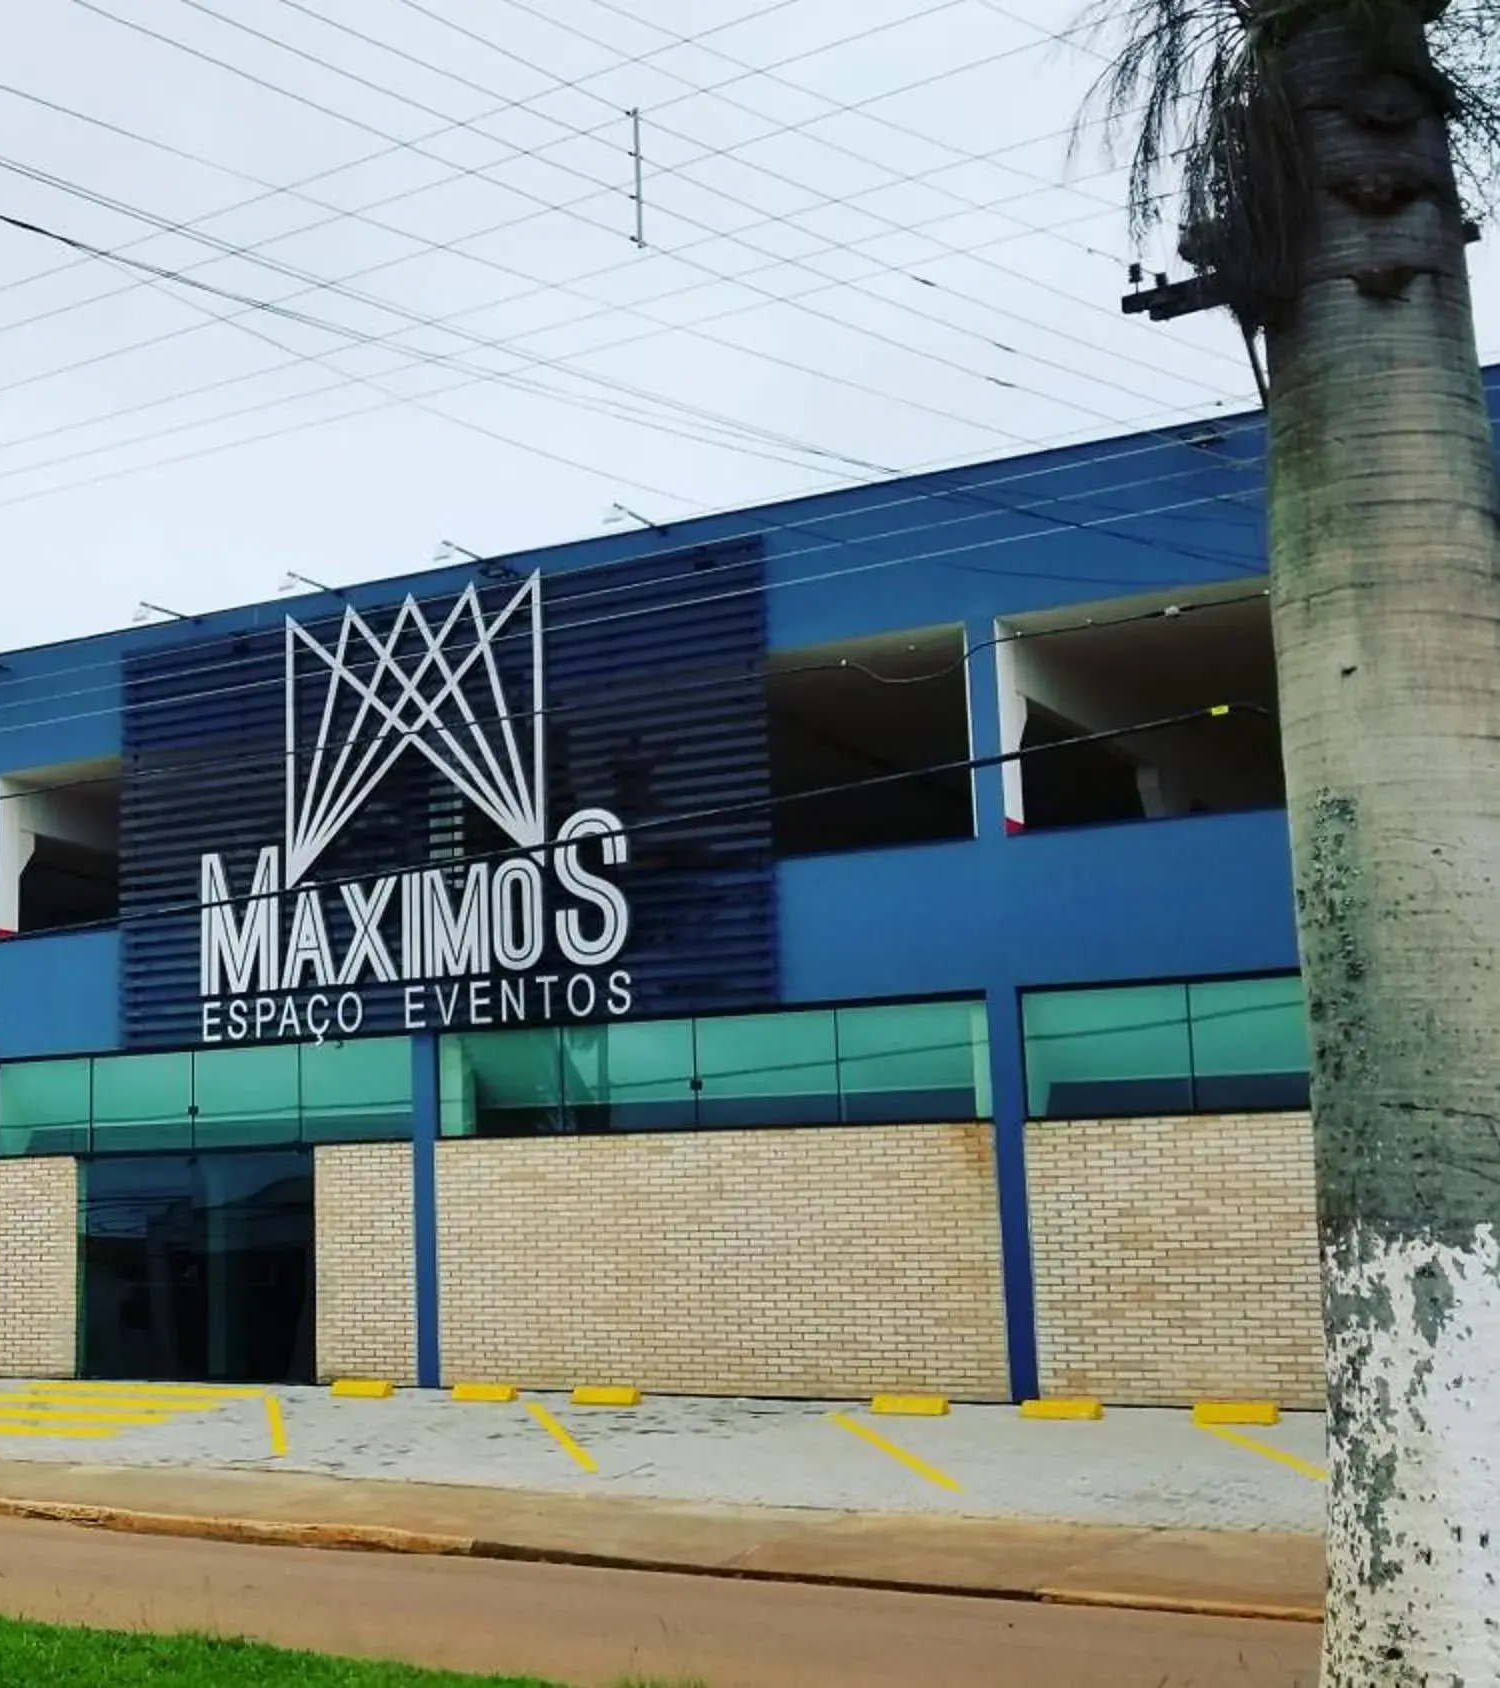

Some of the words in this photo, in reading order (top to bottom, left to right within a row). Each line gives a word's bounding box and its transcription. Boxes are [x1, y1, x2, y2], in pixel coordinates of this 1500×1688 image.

[201, 808, 628, 997] MAXIMOS
[202, 992, 363, 1045] ESPAÇO
[405, 971, 632, 1029] EVENTOS
